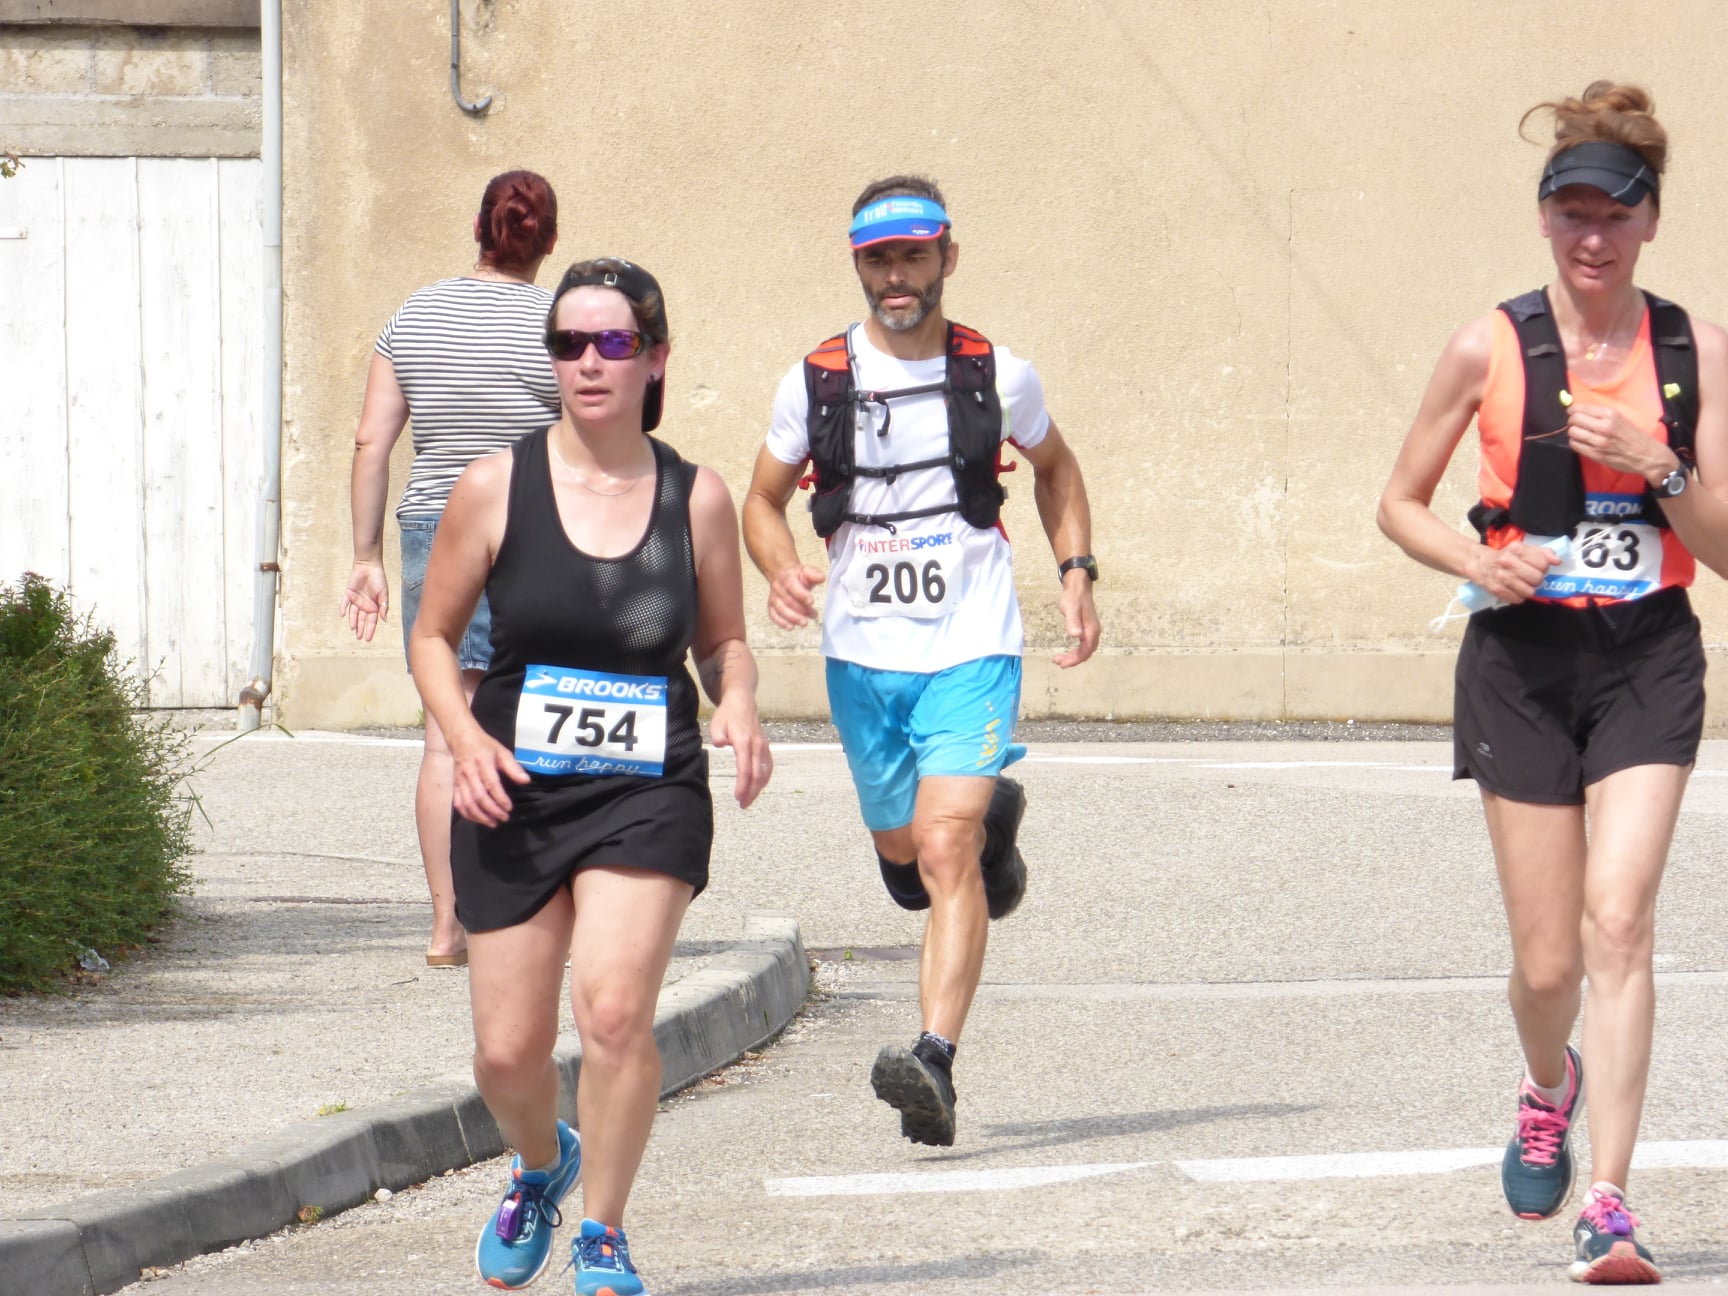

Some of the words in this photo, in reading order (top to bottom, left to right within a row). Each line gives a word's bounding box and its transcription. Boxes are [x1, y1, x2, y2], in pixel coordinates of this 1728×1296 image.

[1585, 500, 1643, 516] ROOK
[862, 532, 953, 553] INTERSPORT
[1573, 527, 1639, 571] 63
[866, 559, 946, 604] 206
[1538, 578, 1576, 592] run
[1579, 578, 1640, 599] happy
[556, 676, 662, 700] BROOKS
[543, 702, 639, 752] 754
[530, 755, 572, 769] run
[575, 756, 641, 775] happy
